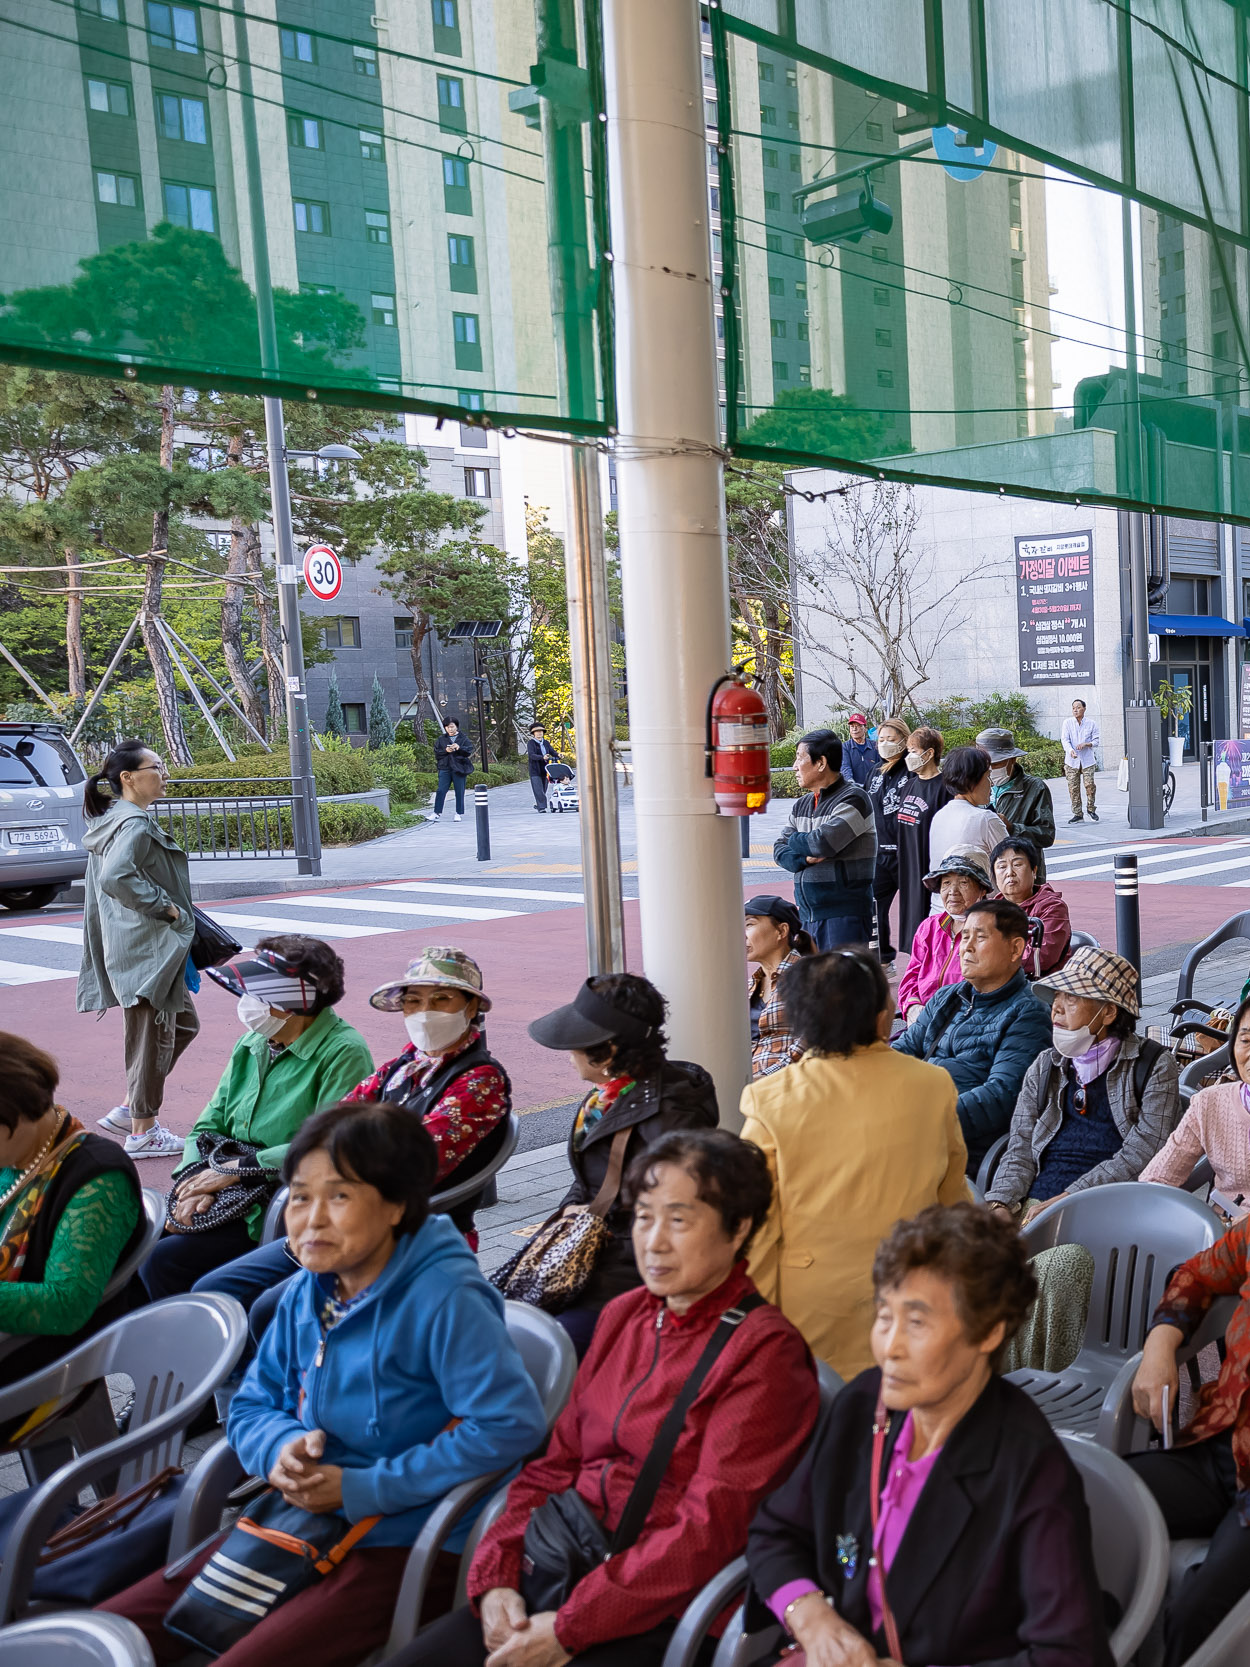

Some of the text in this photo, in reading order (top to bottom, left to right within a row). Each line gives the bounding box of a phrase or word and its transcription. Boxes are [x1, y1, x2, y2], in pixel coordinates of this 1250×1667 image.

[312, 560, 335, 585] 30
[1019, 555, 1090, 581] 가정의달 이벤트
[1071, 617, 1087, 628] 개시
[34, 831, 54, 841] 5694
